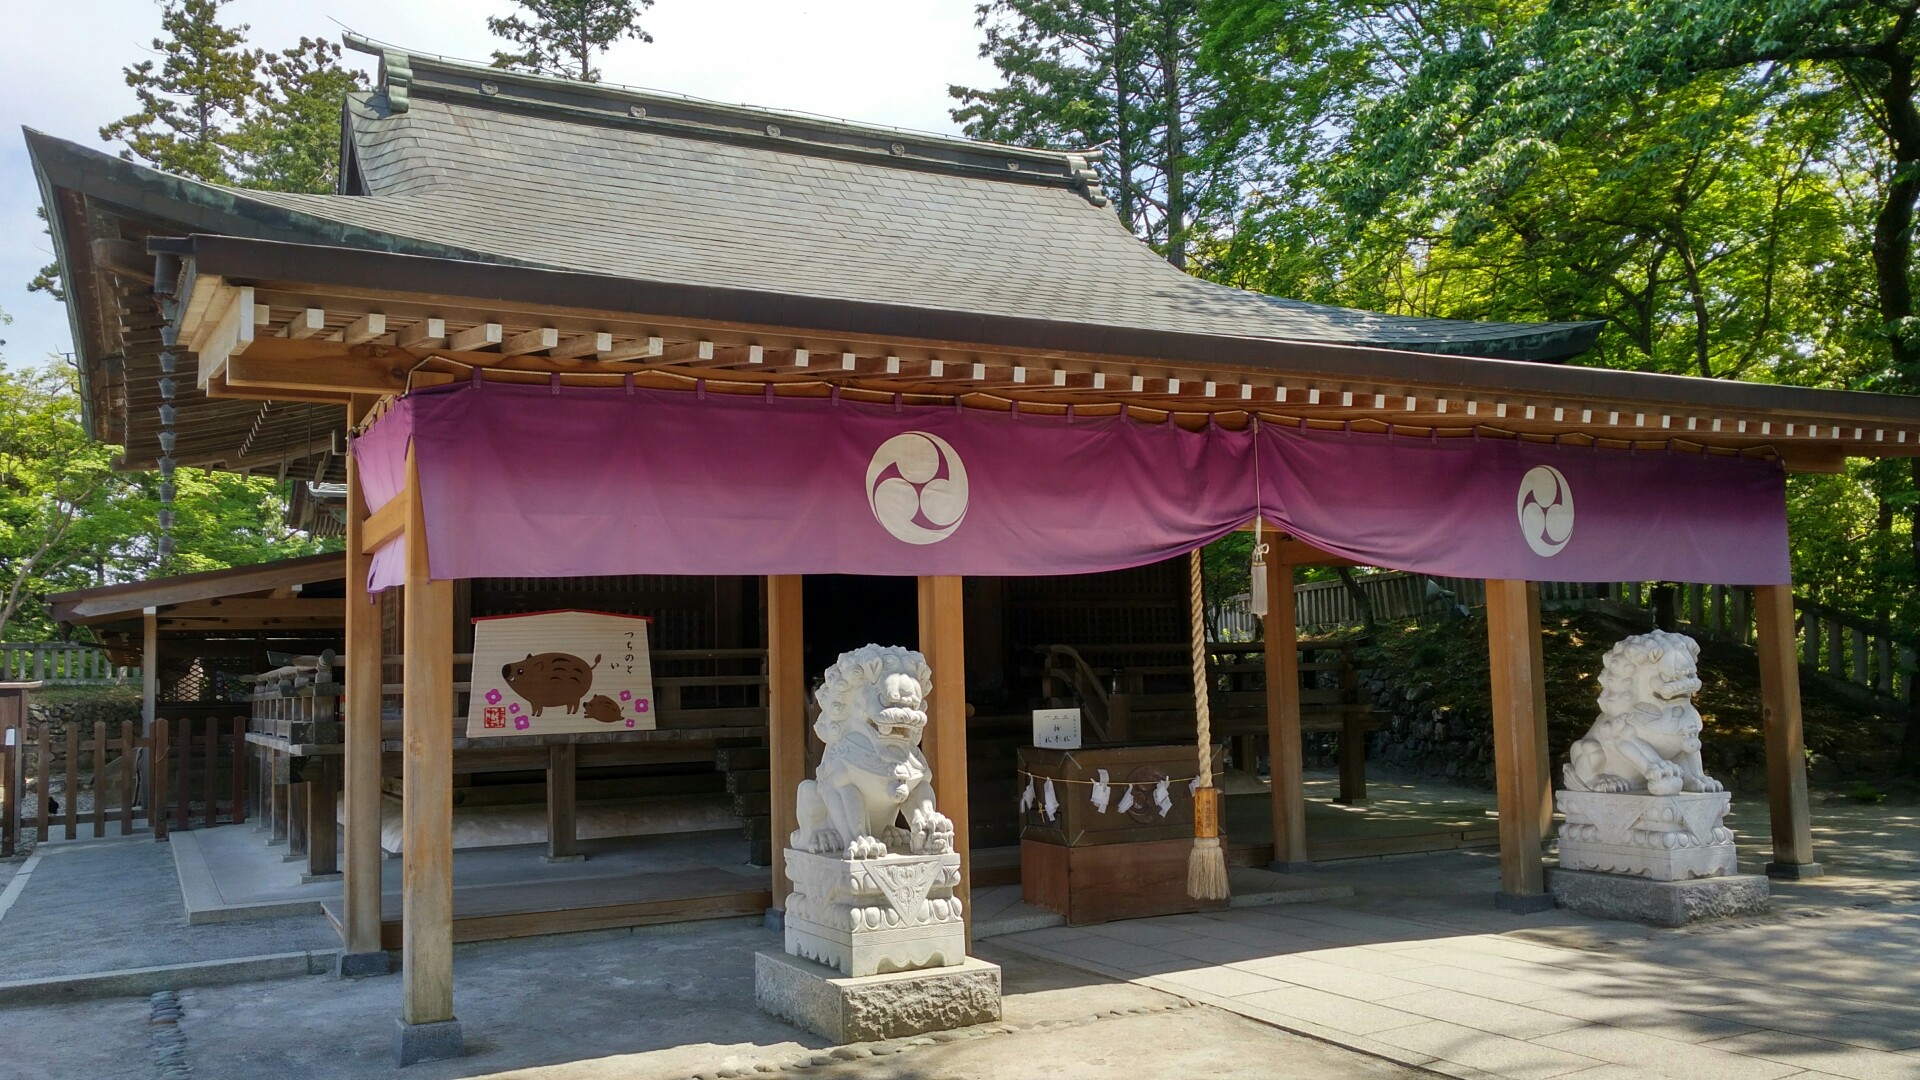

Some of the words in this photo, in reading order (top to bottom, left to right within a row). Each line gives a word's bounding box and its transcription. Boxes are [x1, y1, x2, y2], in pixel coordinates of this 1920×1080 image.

[610, 662, 620, 670] い
[624, 631, 634, 675] つちのと
